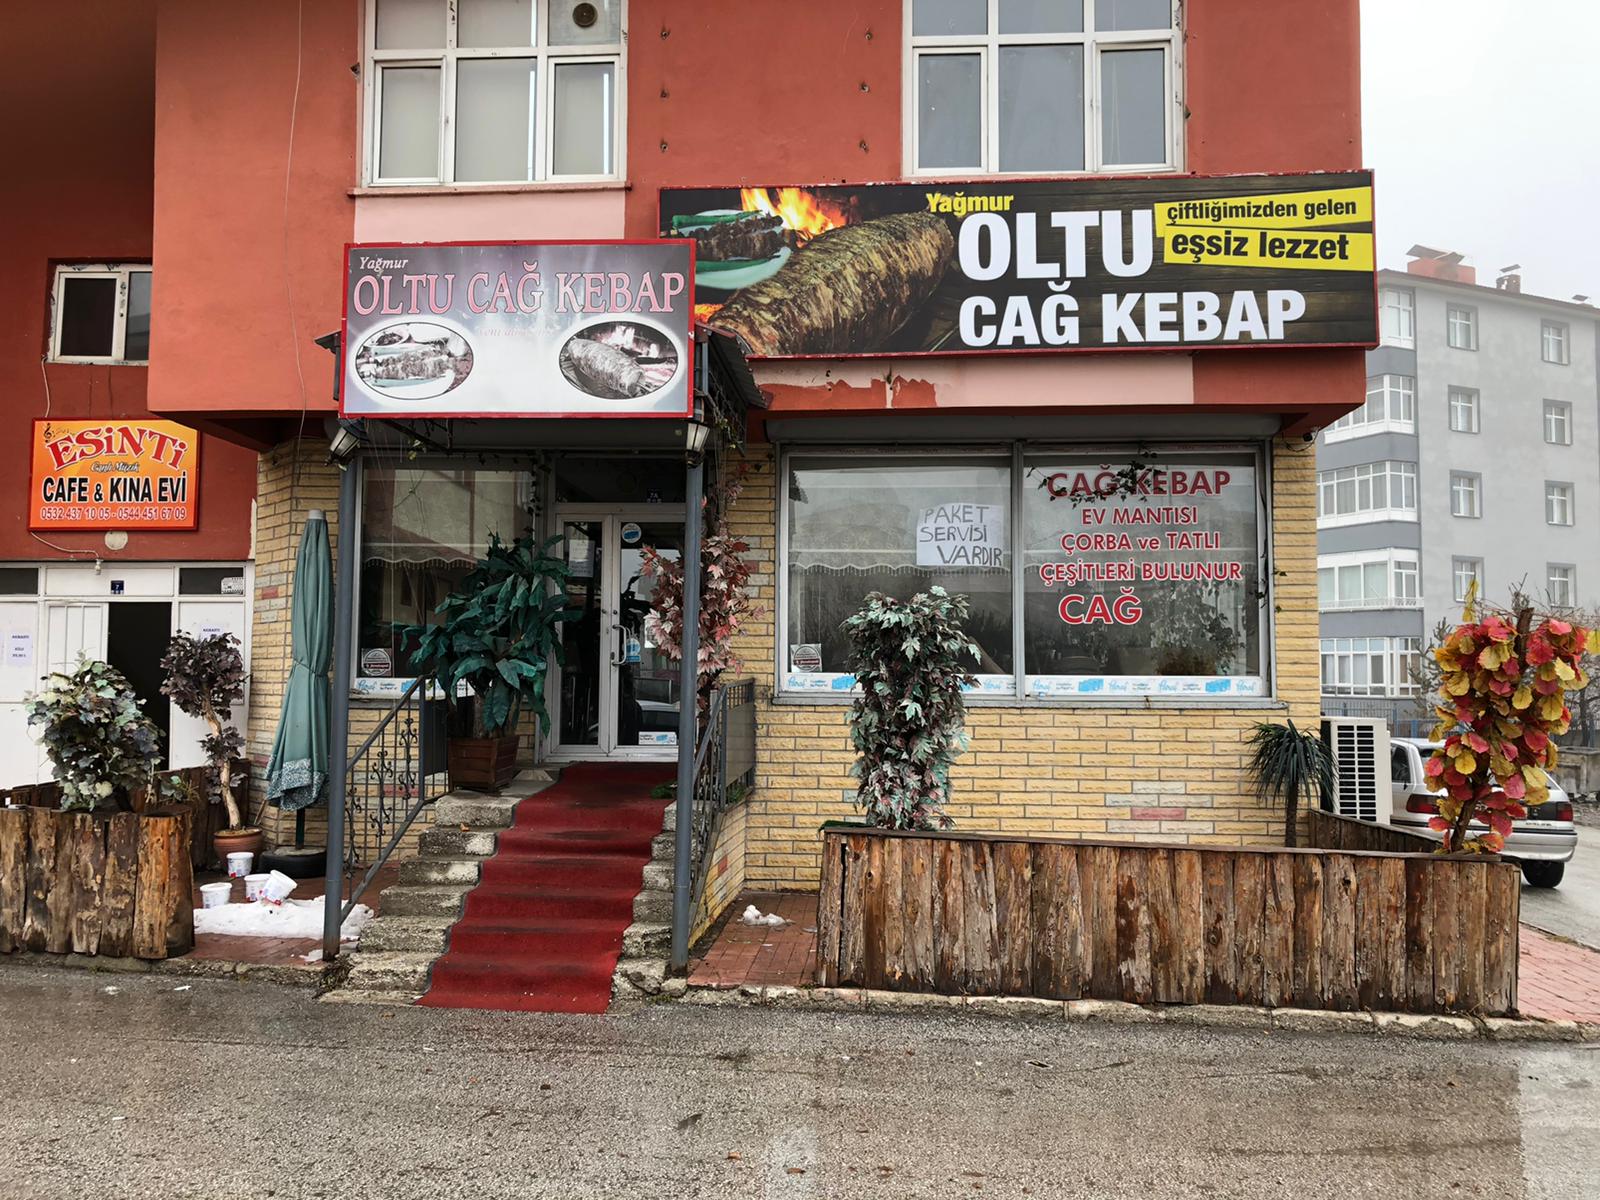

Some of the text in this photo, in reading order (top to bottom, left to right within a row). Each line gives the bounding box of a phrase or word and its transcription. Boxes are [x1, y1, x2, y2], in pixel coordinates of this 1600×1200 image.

[926, 192, 1014, 217] Yağmur
[1167, 198, 1357, 225] çiftliğimizden gelen
[958, 209, 1153, 280] OLTU
[1172, 230, 1349, 263] eşsiz lezzet
[359, 256, 408, 272] Yağmur
[353, 261, 685, 315] OLTU CAĞ KEBAP
[958, 280, 1306, 346] CAĞ KEBAP
[43, 471, 186, 502] CAFE & KINA EVİ
[1046, 464, 1231, 497] CAĞ KEBAP
[41, 507, 64, 520] 0532
[66, 507, 82, 520] 437
[85, 507, 96, 520] 10
[99, 507, 110, 520] 05
[118, 507, 139, 520] 0544
[143, 507, 158, 520] 451
[161, 507, 172, 520] 67
[174, 507, 186, 520] 09
[924, 505, 990, 523] PAKET
[1081, 507, 1198, 525] EV MANTISI
[937, 545, 1003, 566] VARDIR
[1061, 532, 1221, 556] ÇORBA ve TATLI
[1040, 559, 1243, 586] ÇEŞİTLERİ BULUNUR
[1058, 587, 1143, 625] CAĞ
